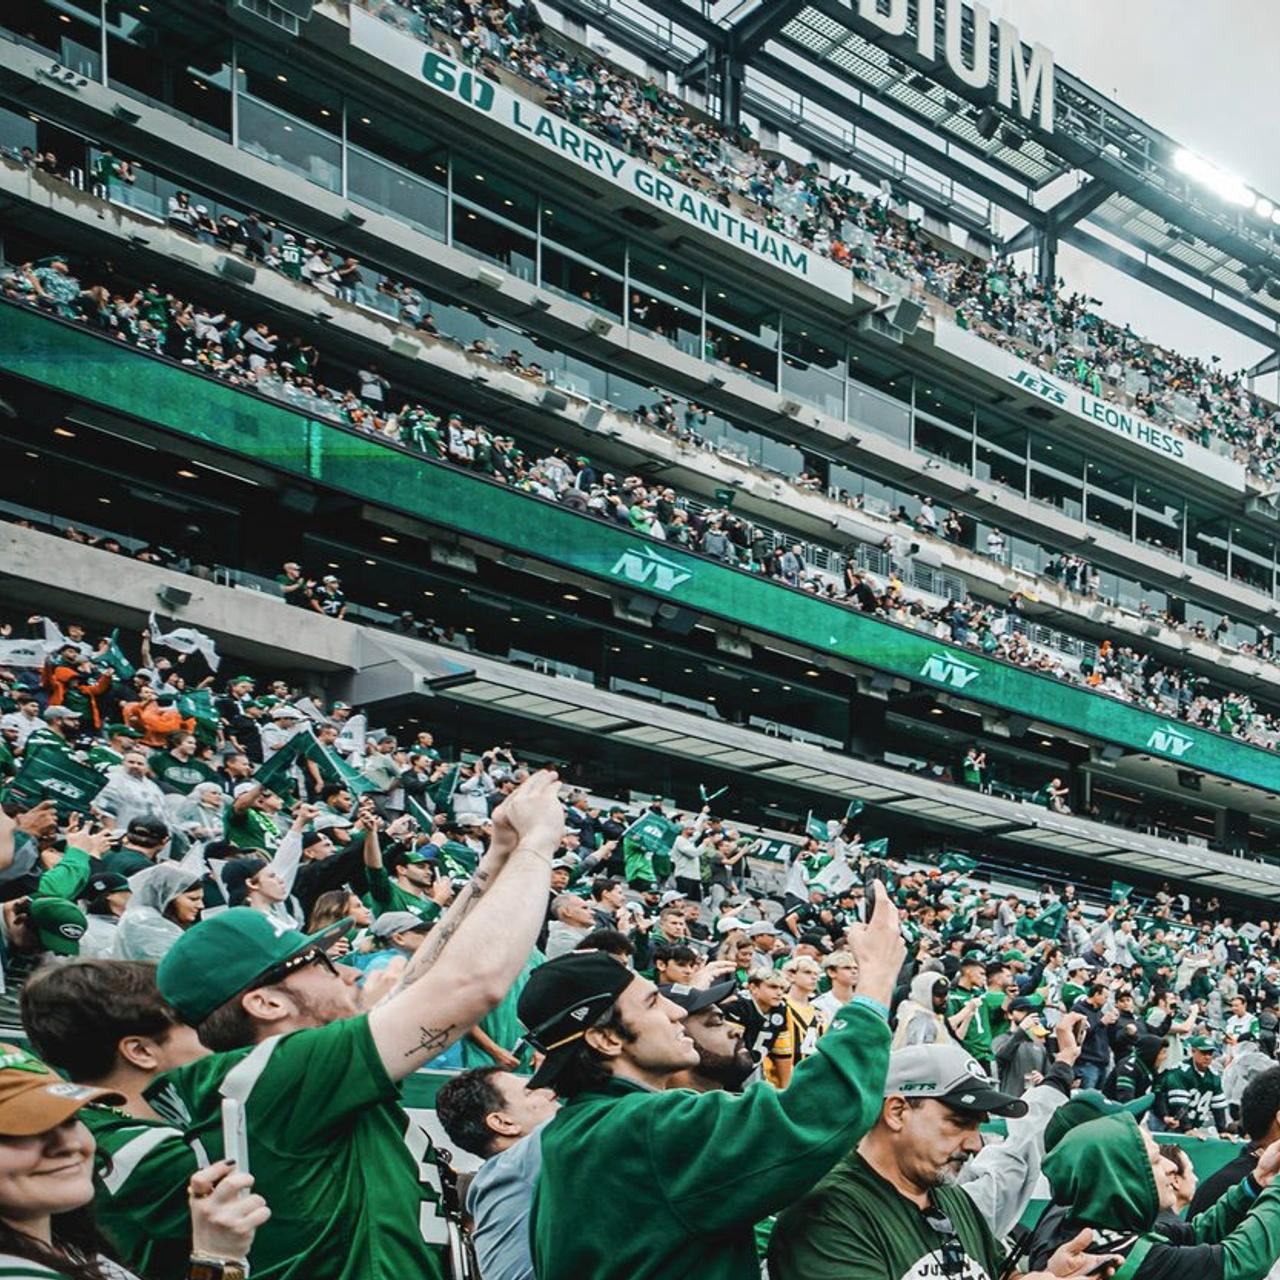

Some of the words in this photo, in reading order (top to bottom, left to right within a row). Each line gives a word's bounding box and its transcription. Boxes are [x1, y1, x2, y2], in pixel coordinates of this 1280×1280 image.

[422, 51, 495, 112] 60
[513, 100, 626, 178] LARRY
[633, 168, 808, 275] GRANTHAM
[1008, 370, 1069, 405] JETS
[1080, 396, 1133, 434] LEON
[1137, 421, 1185, 458] HESS
[610, 546, 693, 592] NY
[920, 651, 981, 688] NY
[1147, 724, 1194, 757] NY
[899, 1082, 937, 1092] JETS
